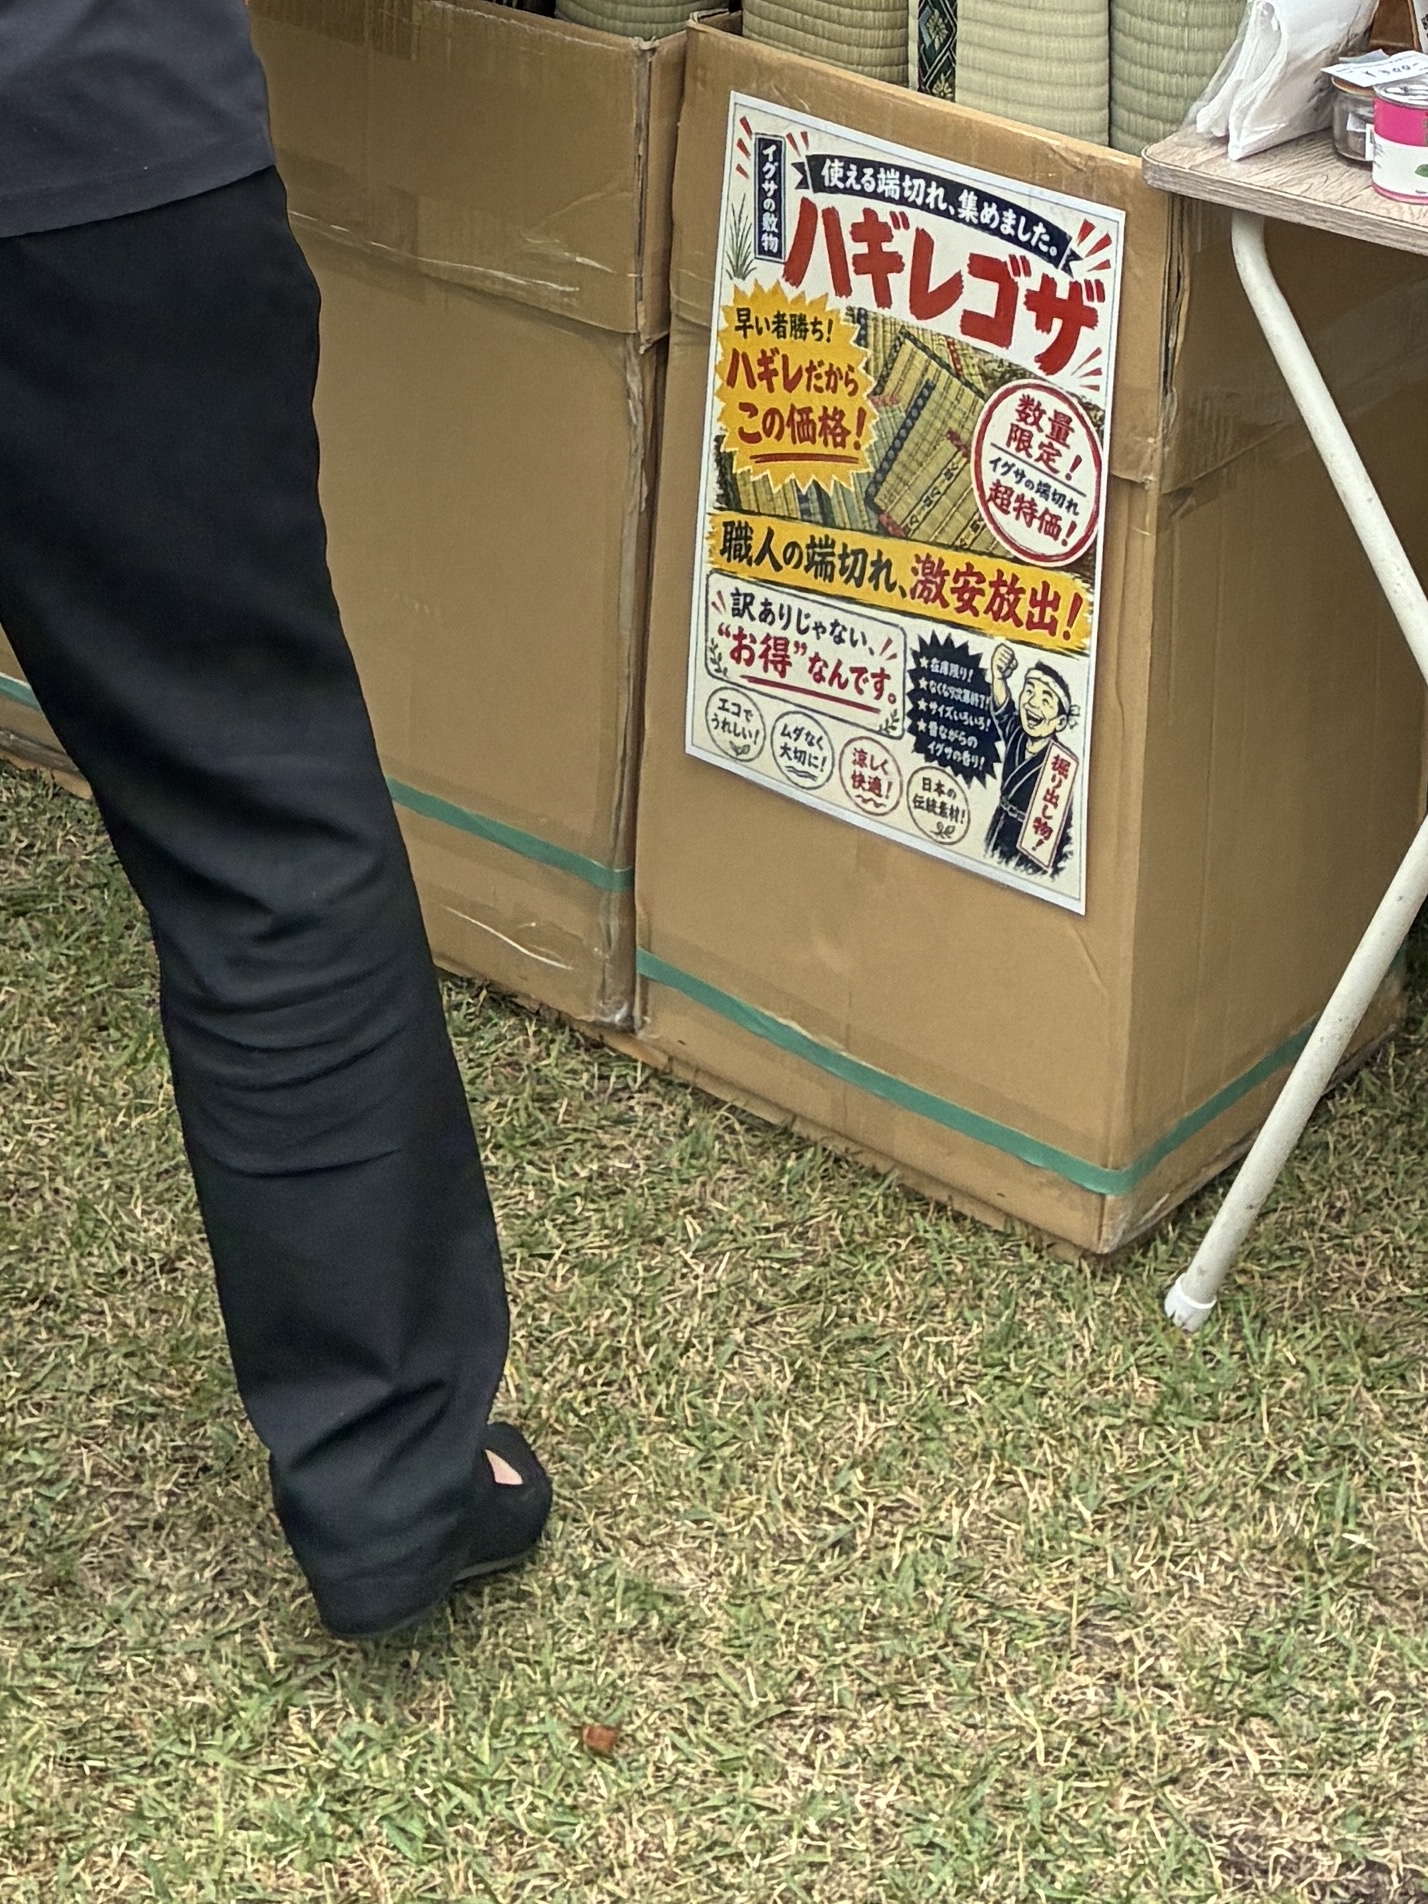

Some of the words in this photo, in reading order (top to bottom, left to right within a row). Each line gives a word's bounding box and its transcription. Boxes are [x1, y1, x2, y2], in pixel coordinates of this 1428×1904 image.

[761, 145, 780, 254] イグサの敷物
[821, 159, 1058, 257] 使える端切れ、集めました。
[782, 197, 1106, 375] ハギレゴザ
[734, 307, 833, 343] 早い者勝ち!
[726, 347, 860, 397] ハギレだから
[737, 402, 867, 451] この価格!
[1013, 393, 1075, 447] 数量
[1005, 423, 1083, 481] 限定!
[987, 456, 1080, 516] イグサの端切れ
[986, 481, 1077, 547] 超特価!
[731, 586, 875, 655] 訳ありじゃない、
[711, 713, 759, 744] うれしい!
[717, 698, 754, 720] エコで
[929, 700, 991, 732] サイズいろいろ!
[779, 744, 827, 772] 大切に!
[780, 723, 824, 751] ムダなく
[852, 747, 889, 776] 涼しく
[851, 770, 892, 799] 快適!
[921, 776, 957, 800] 日本の
[1032, 753, 1071, 851] 掘り出し物!
